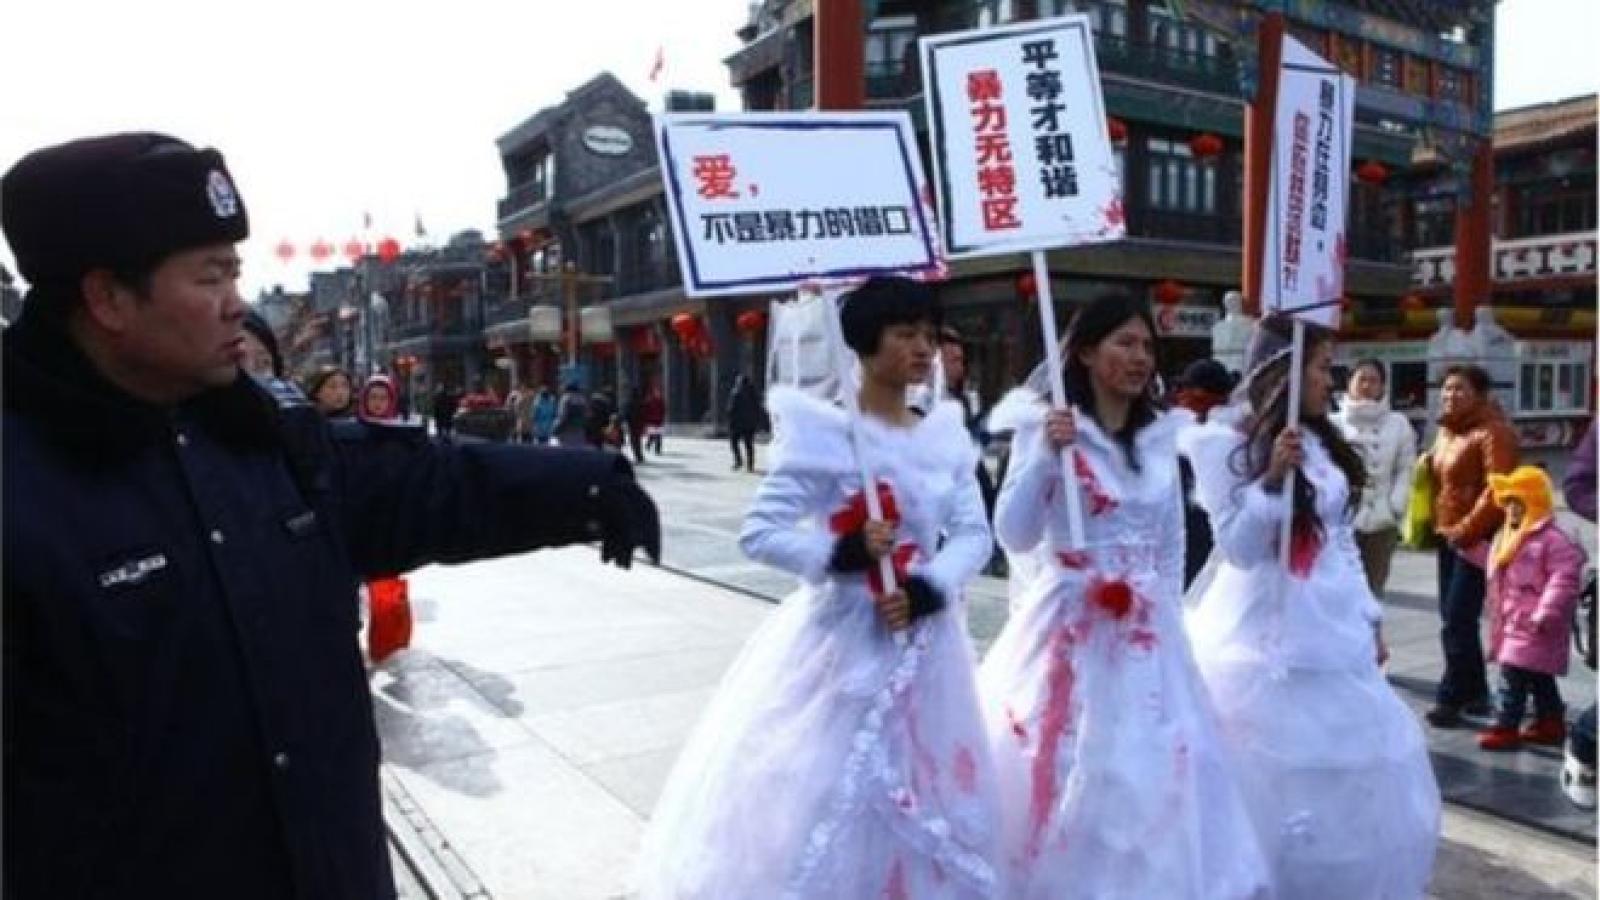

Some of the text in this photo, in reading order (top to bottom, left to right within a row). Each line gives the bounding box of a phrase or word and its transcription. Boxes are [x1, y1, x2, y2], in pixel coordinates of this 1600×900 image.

[966, 69, 1023, 231] 暴力无特区
[1021, 39, 1079, 199] 平等才和谐
[700, 205, 911, 245] 不是暴力的借口
